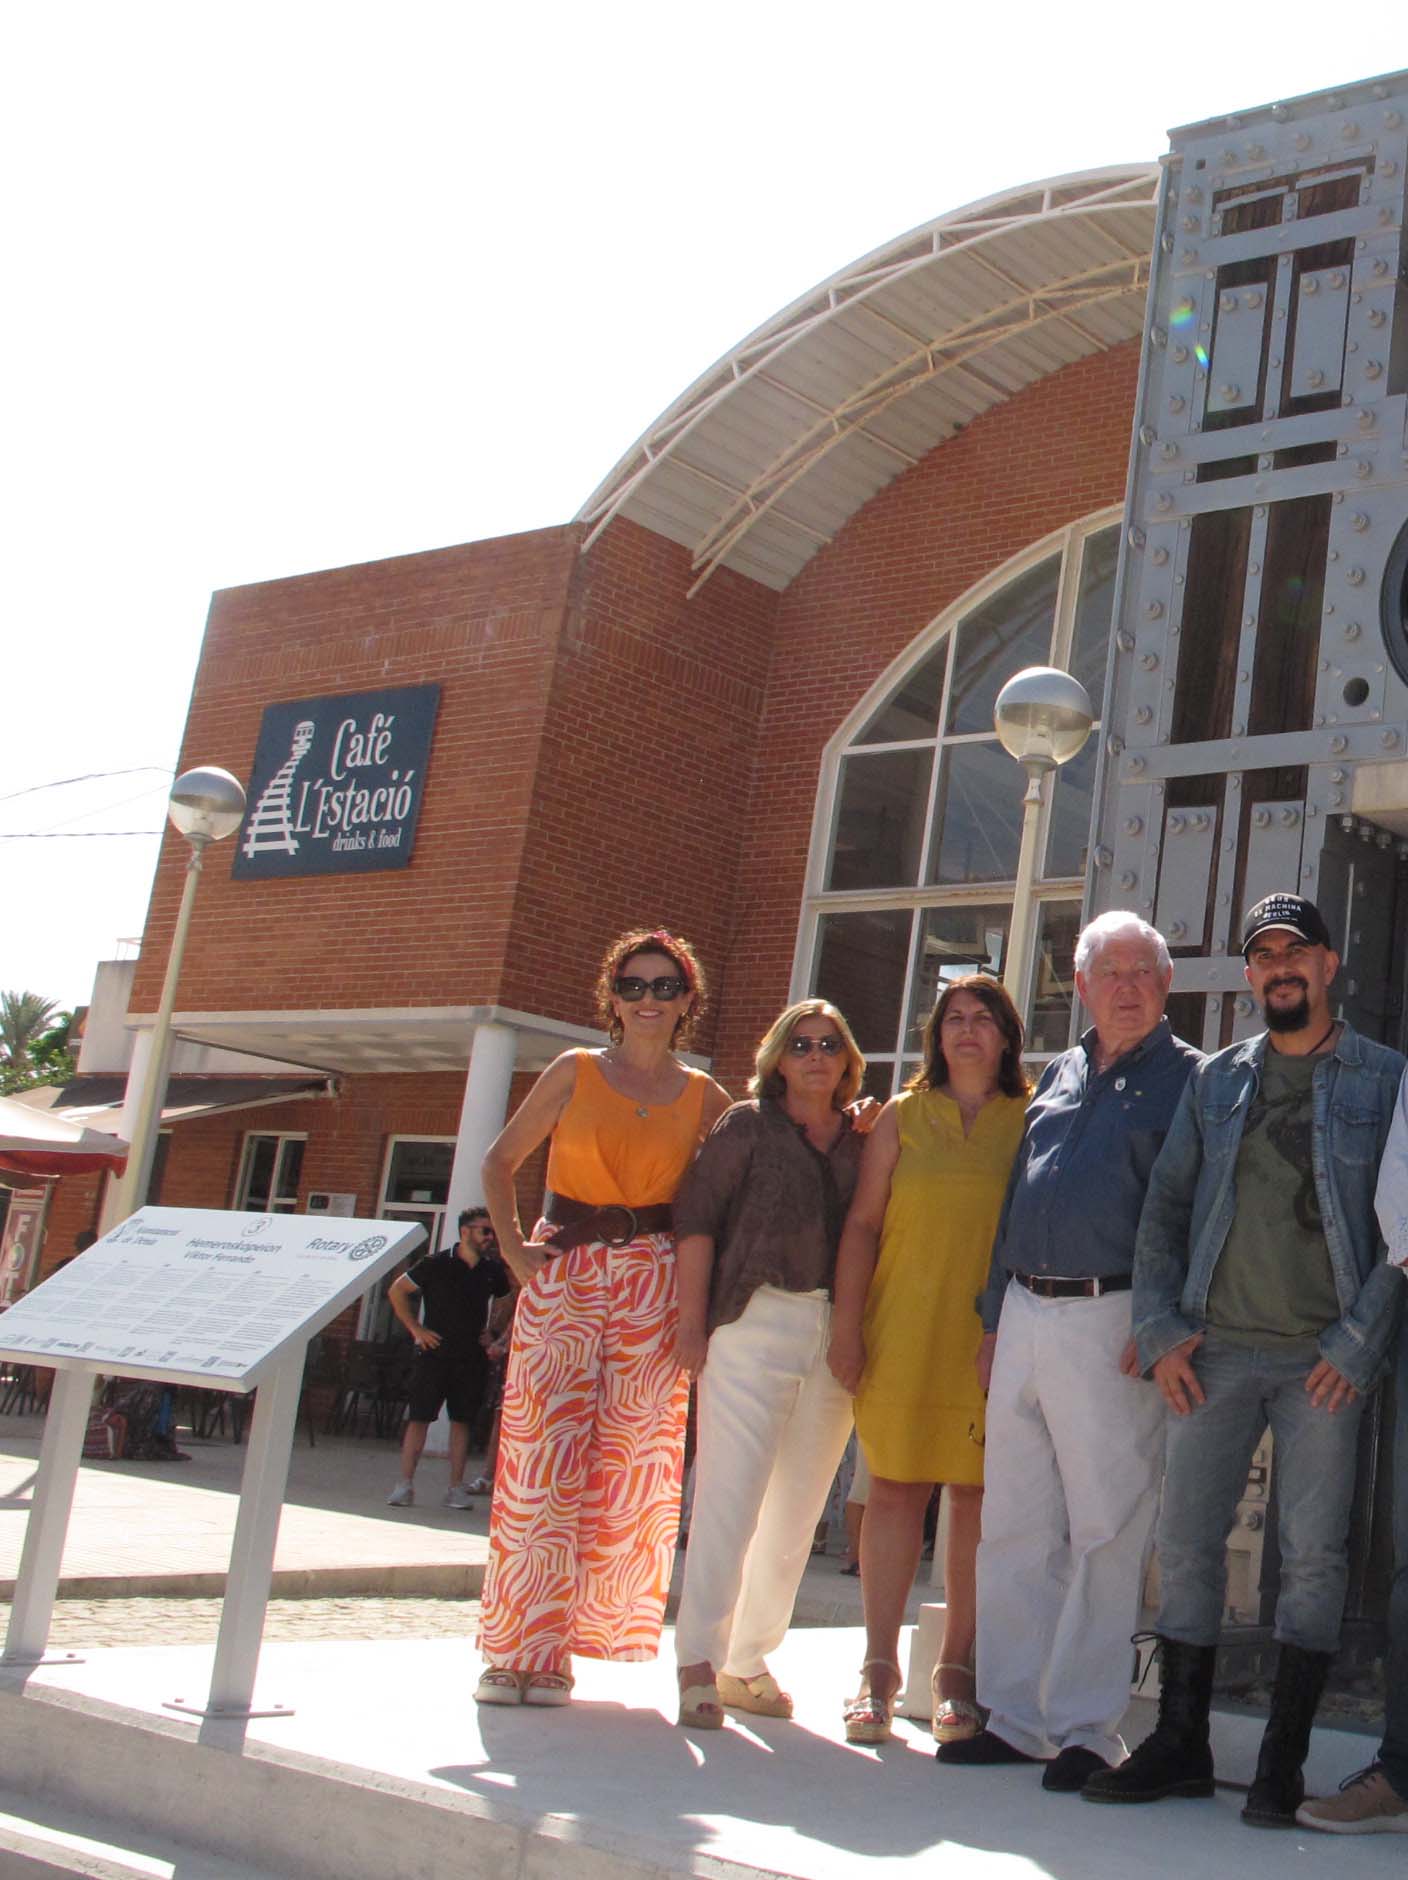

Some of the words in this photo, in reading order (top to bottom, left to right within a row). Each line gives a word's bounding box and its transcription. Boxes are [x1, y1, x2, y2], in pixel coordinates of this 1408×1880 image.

[331, 713, 394, 780] Café
[332, 829, 366, 851] drinks
[367, 829, 376, 848] &
[377, 827, 402, 848] food
[1265, 903, 1302, 912] MACHINA
[306, 1238, 353, 1254] Rotary
